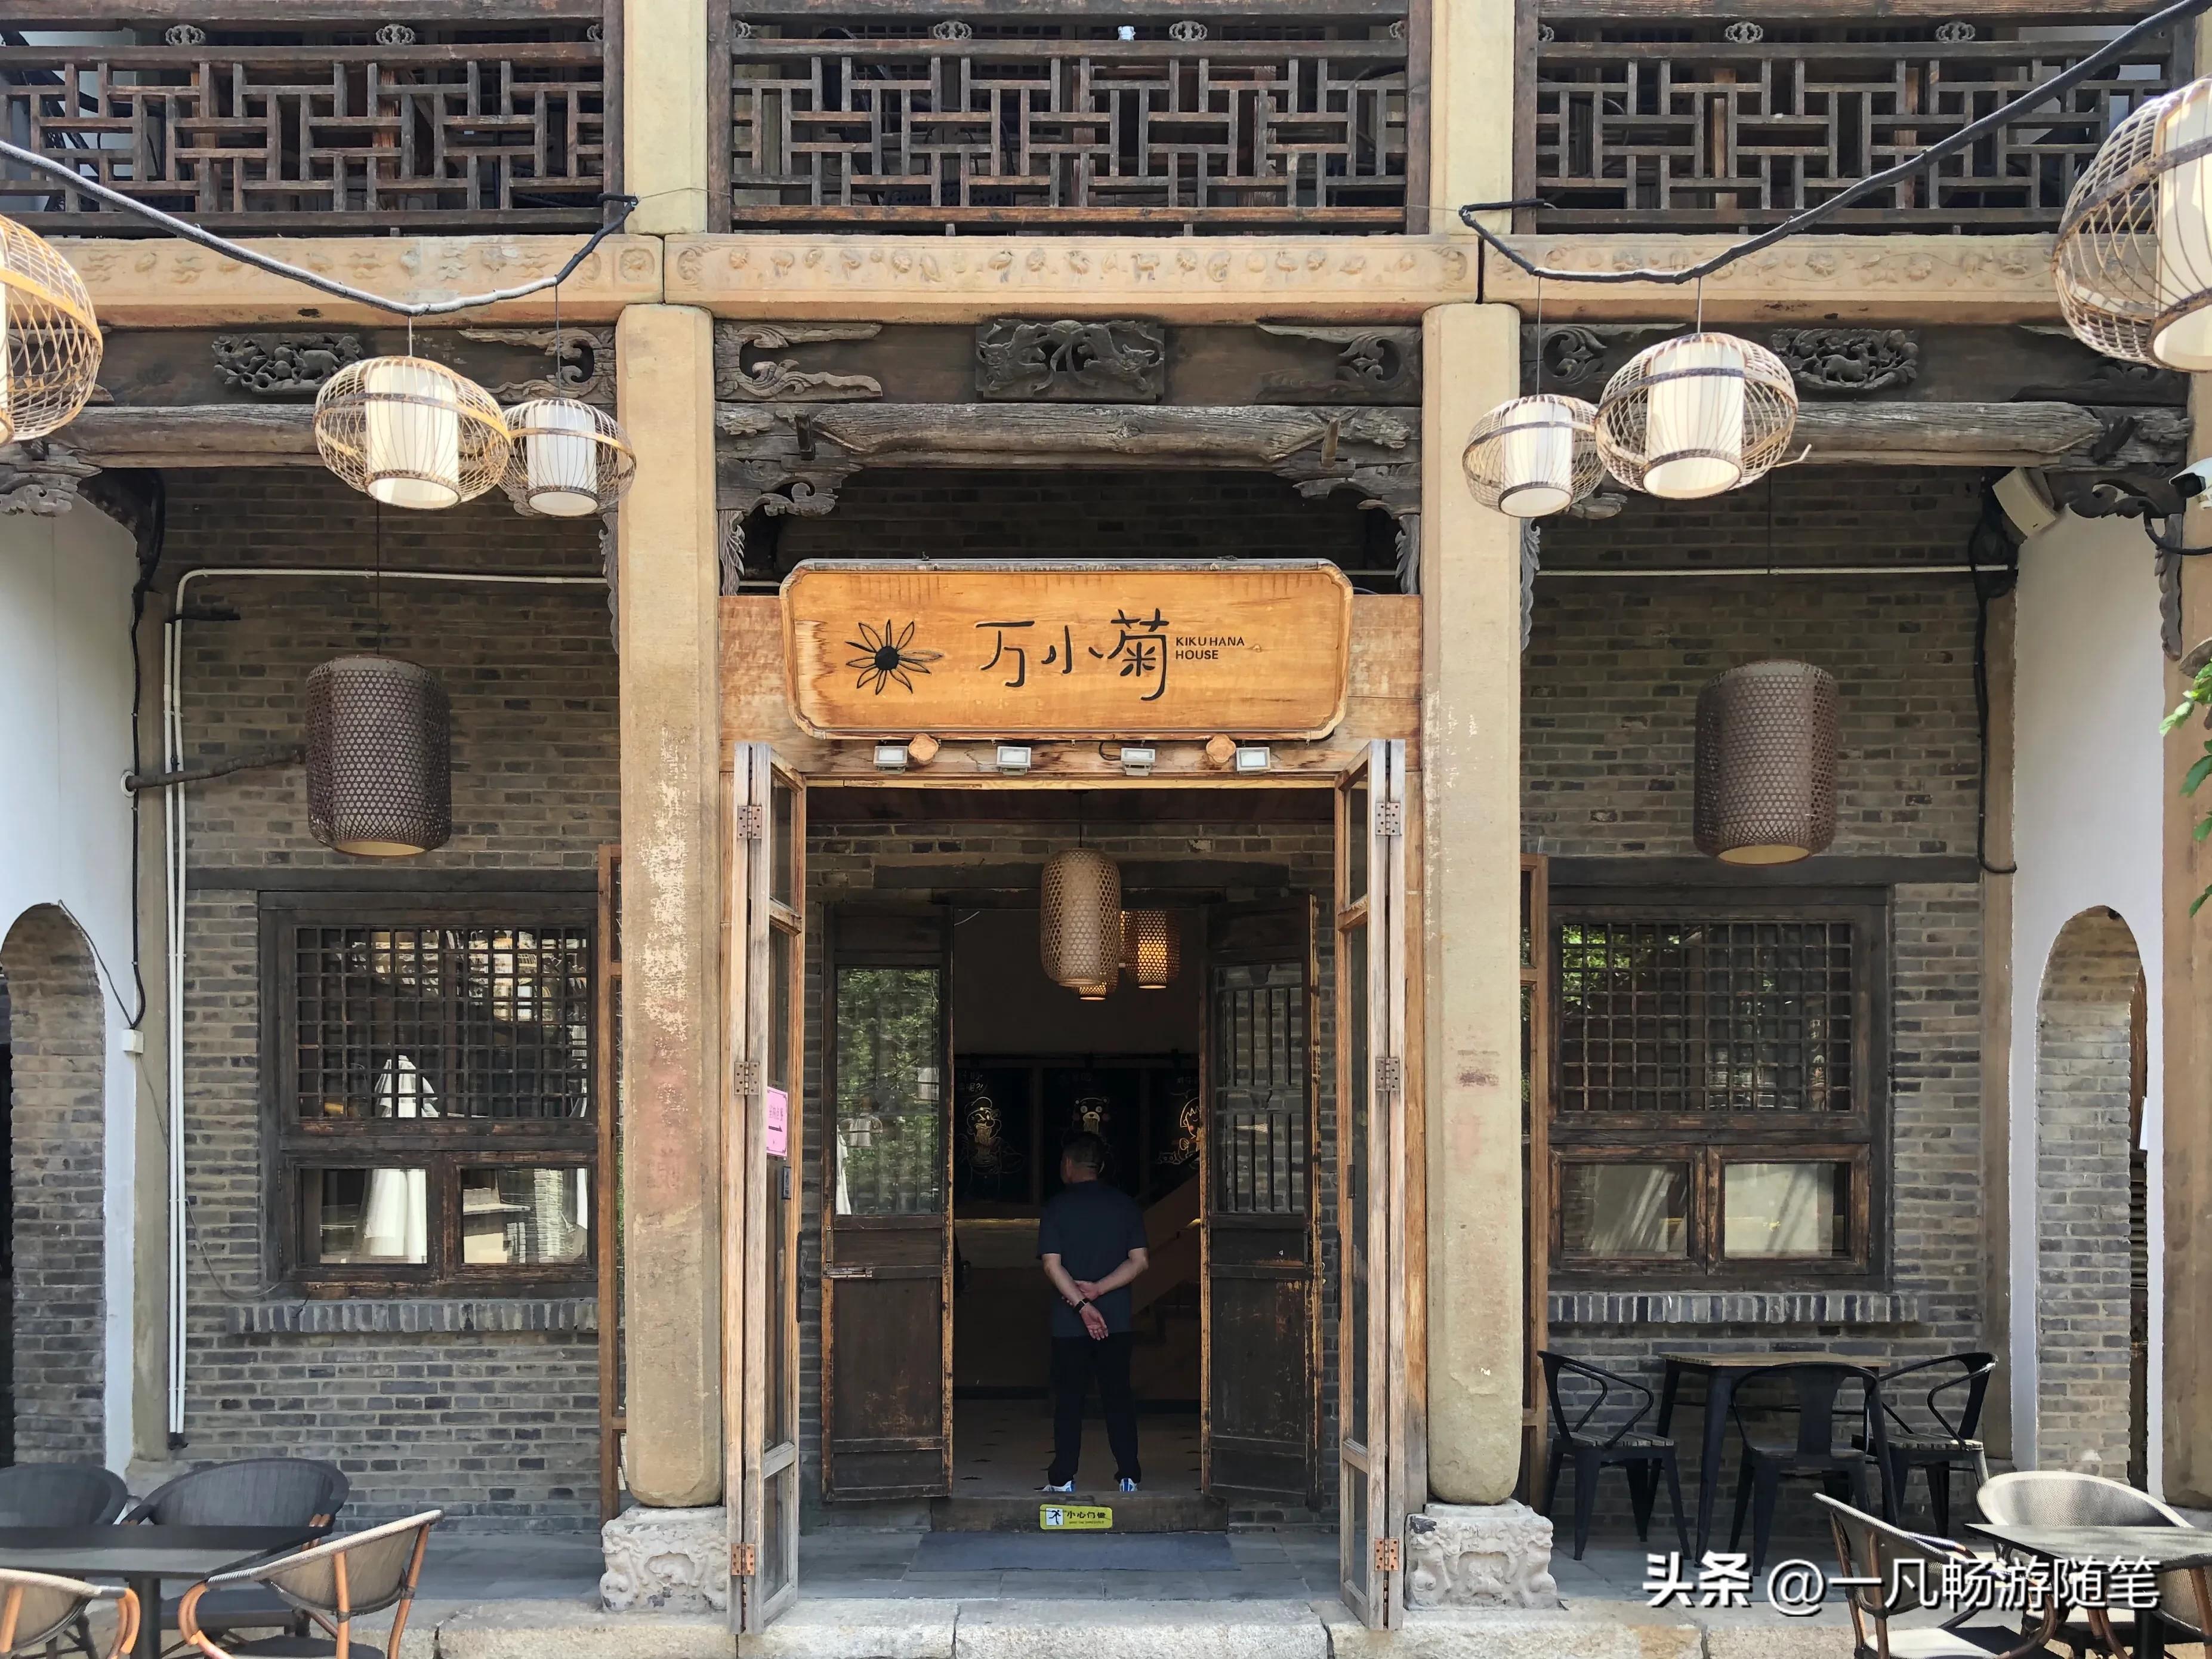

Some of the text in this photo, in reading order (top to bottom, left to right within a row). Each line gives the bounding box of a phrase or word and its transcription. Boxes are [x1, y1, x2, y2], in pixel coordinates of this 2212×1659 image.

[976, 608, 1170, 701] 万小菊
[1176, 650, 1218, 660] HOUSE
